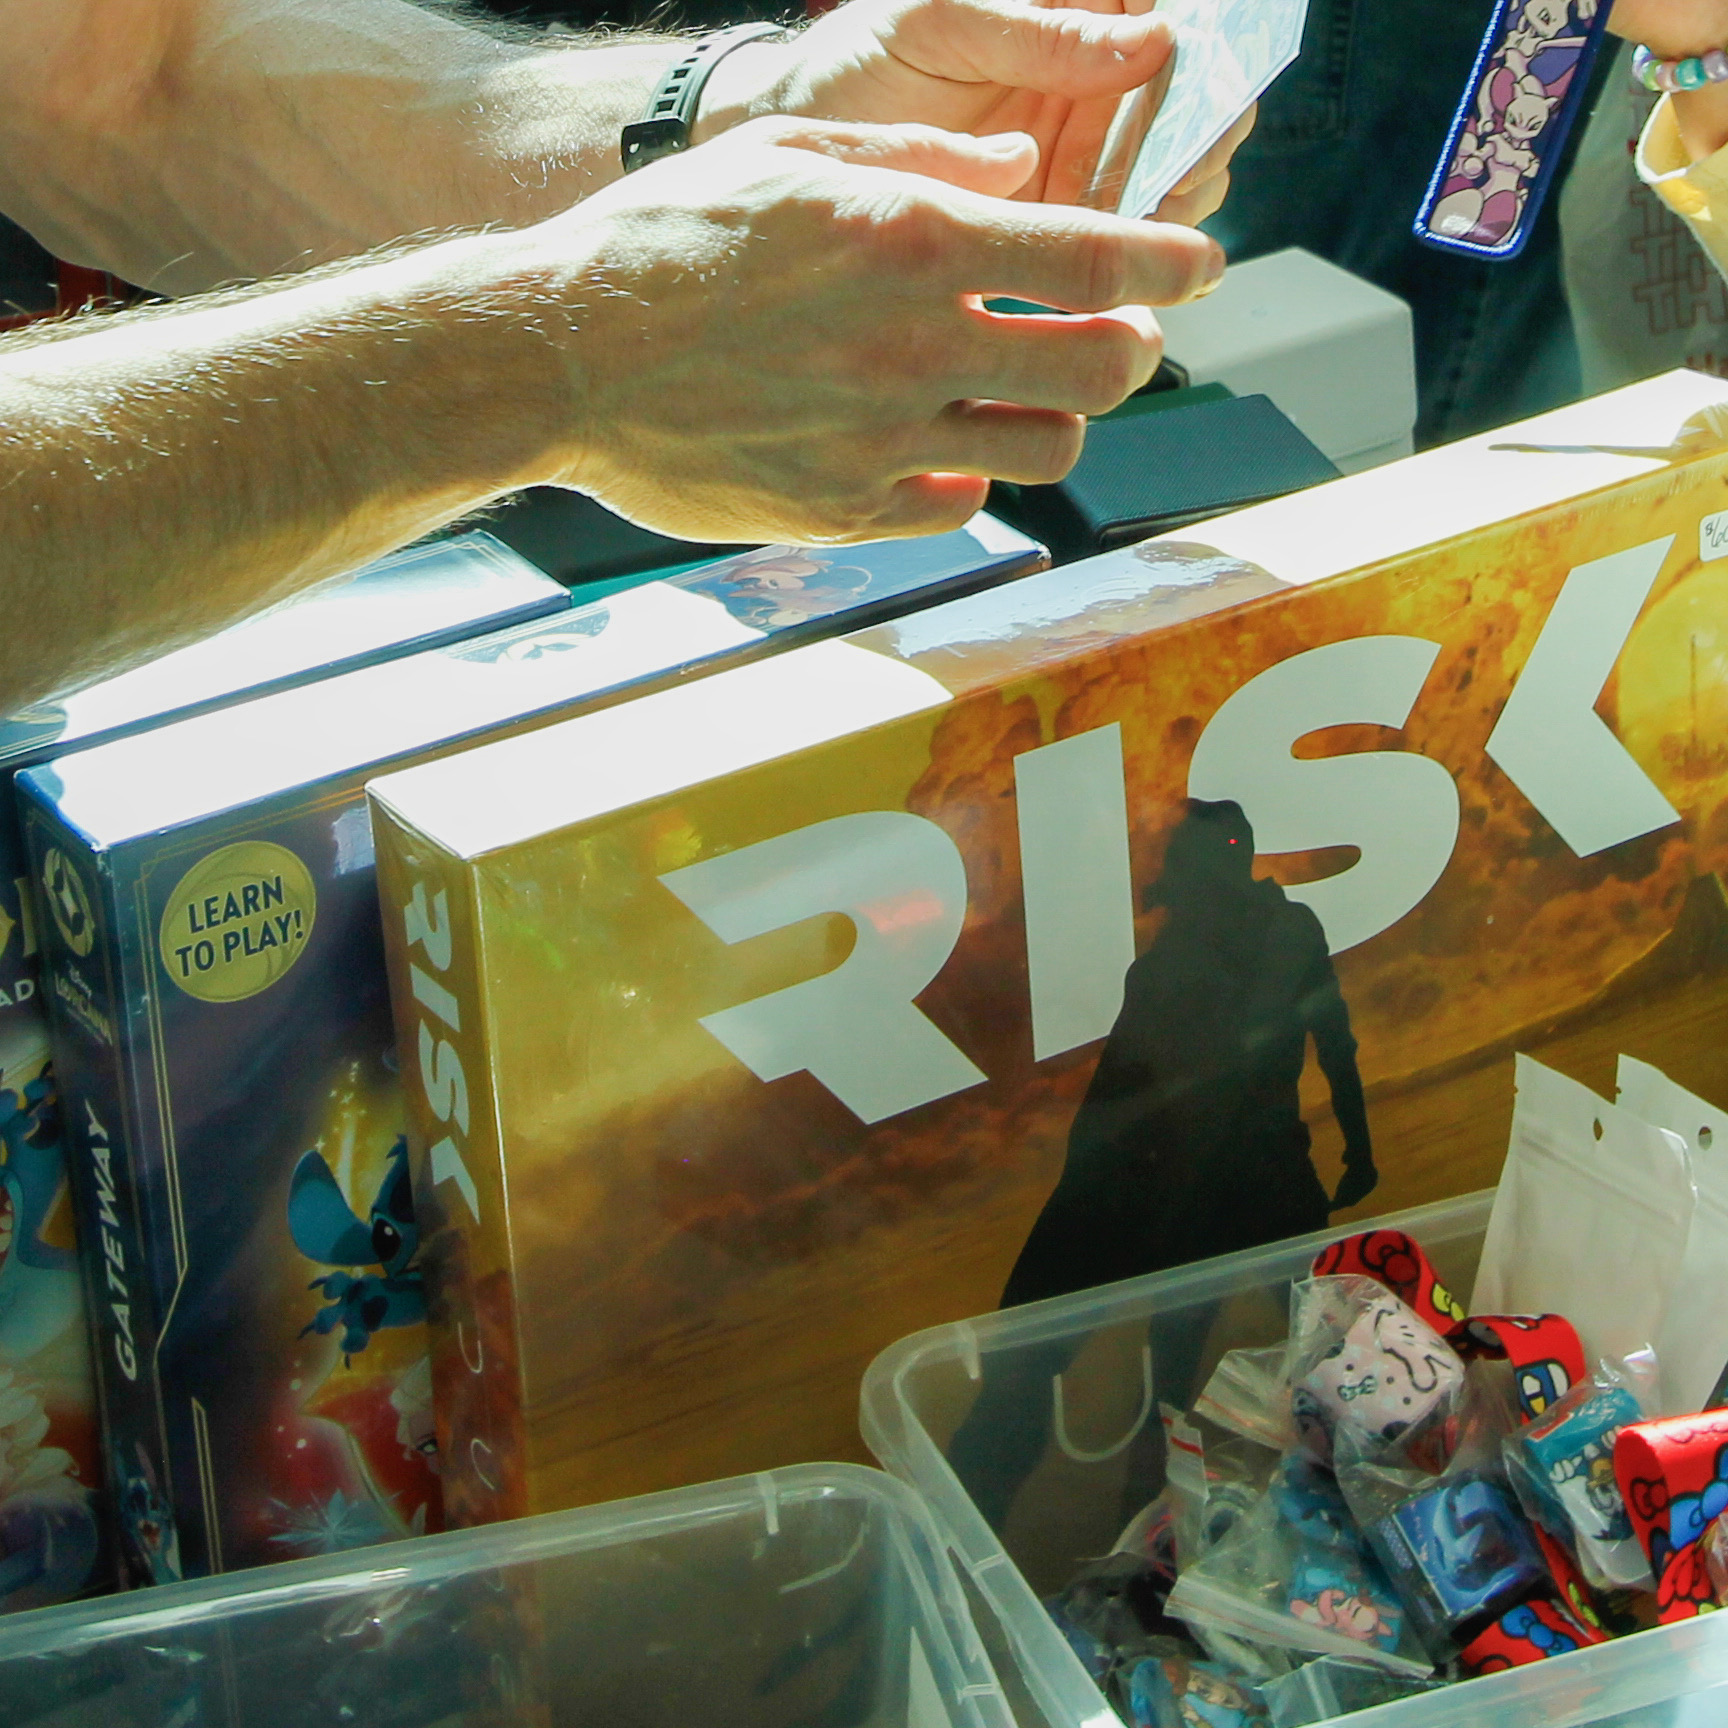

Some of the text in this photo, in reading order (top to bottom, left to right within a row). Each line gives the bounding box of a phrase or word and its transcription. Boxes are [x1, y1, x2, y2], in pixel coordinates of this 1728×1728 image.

[175, 909, 305, 978] TO PLAY!
[188, 874, 284, 934] LEARN
[656, 532, 1681, 1125] RISK
[403, 880, 481, 1225] RISK
[84, 1098, 137, 1382] GATEWAY
